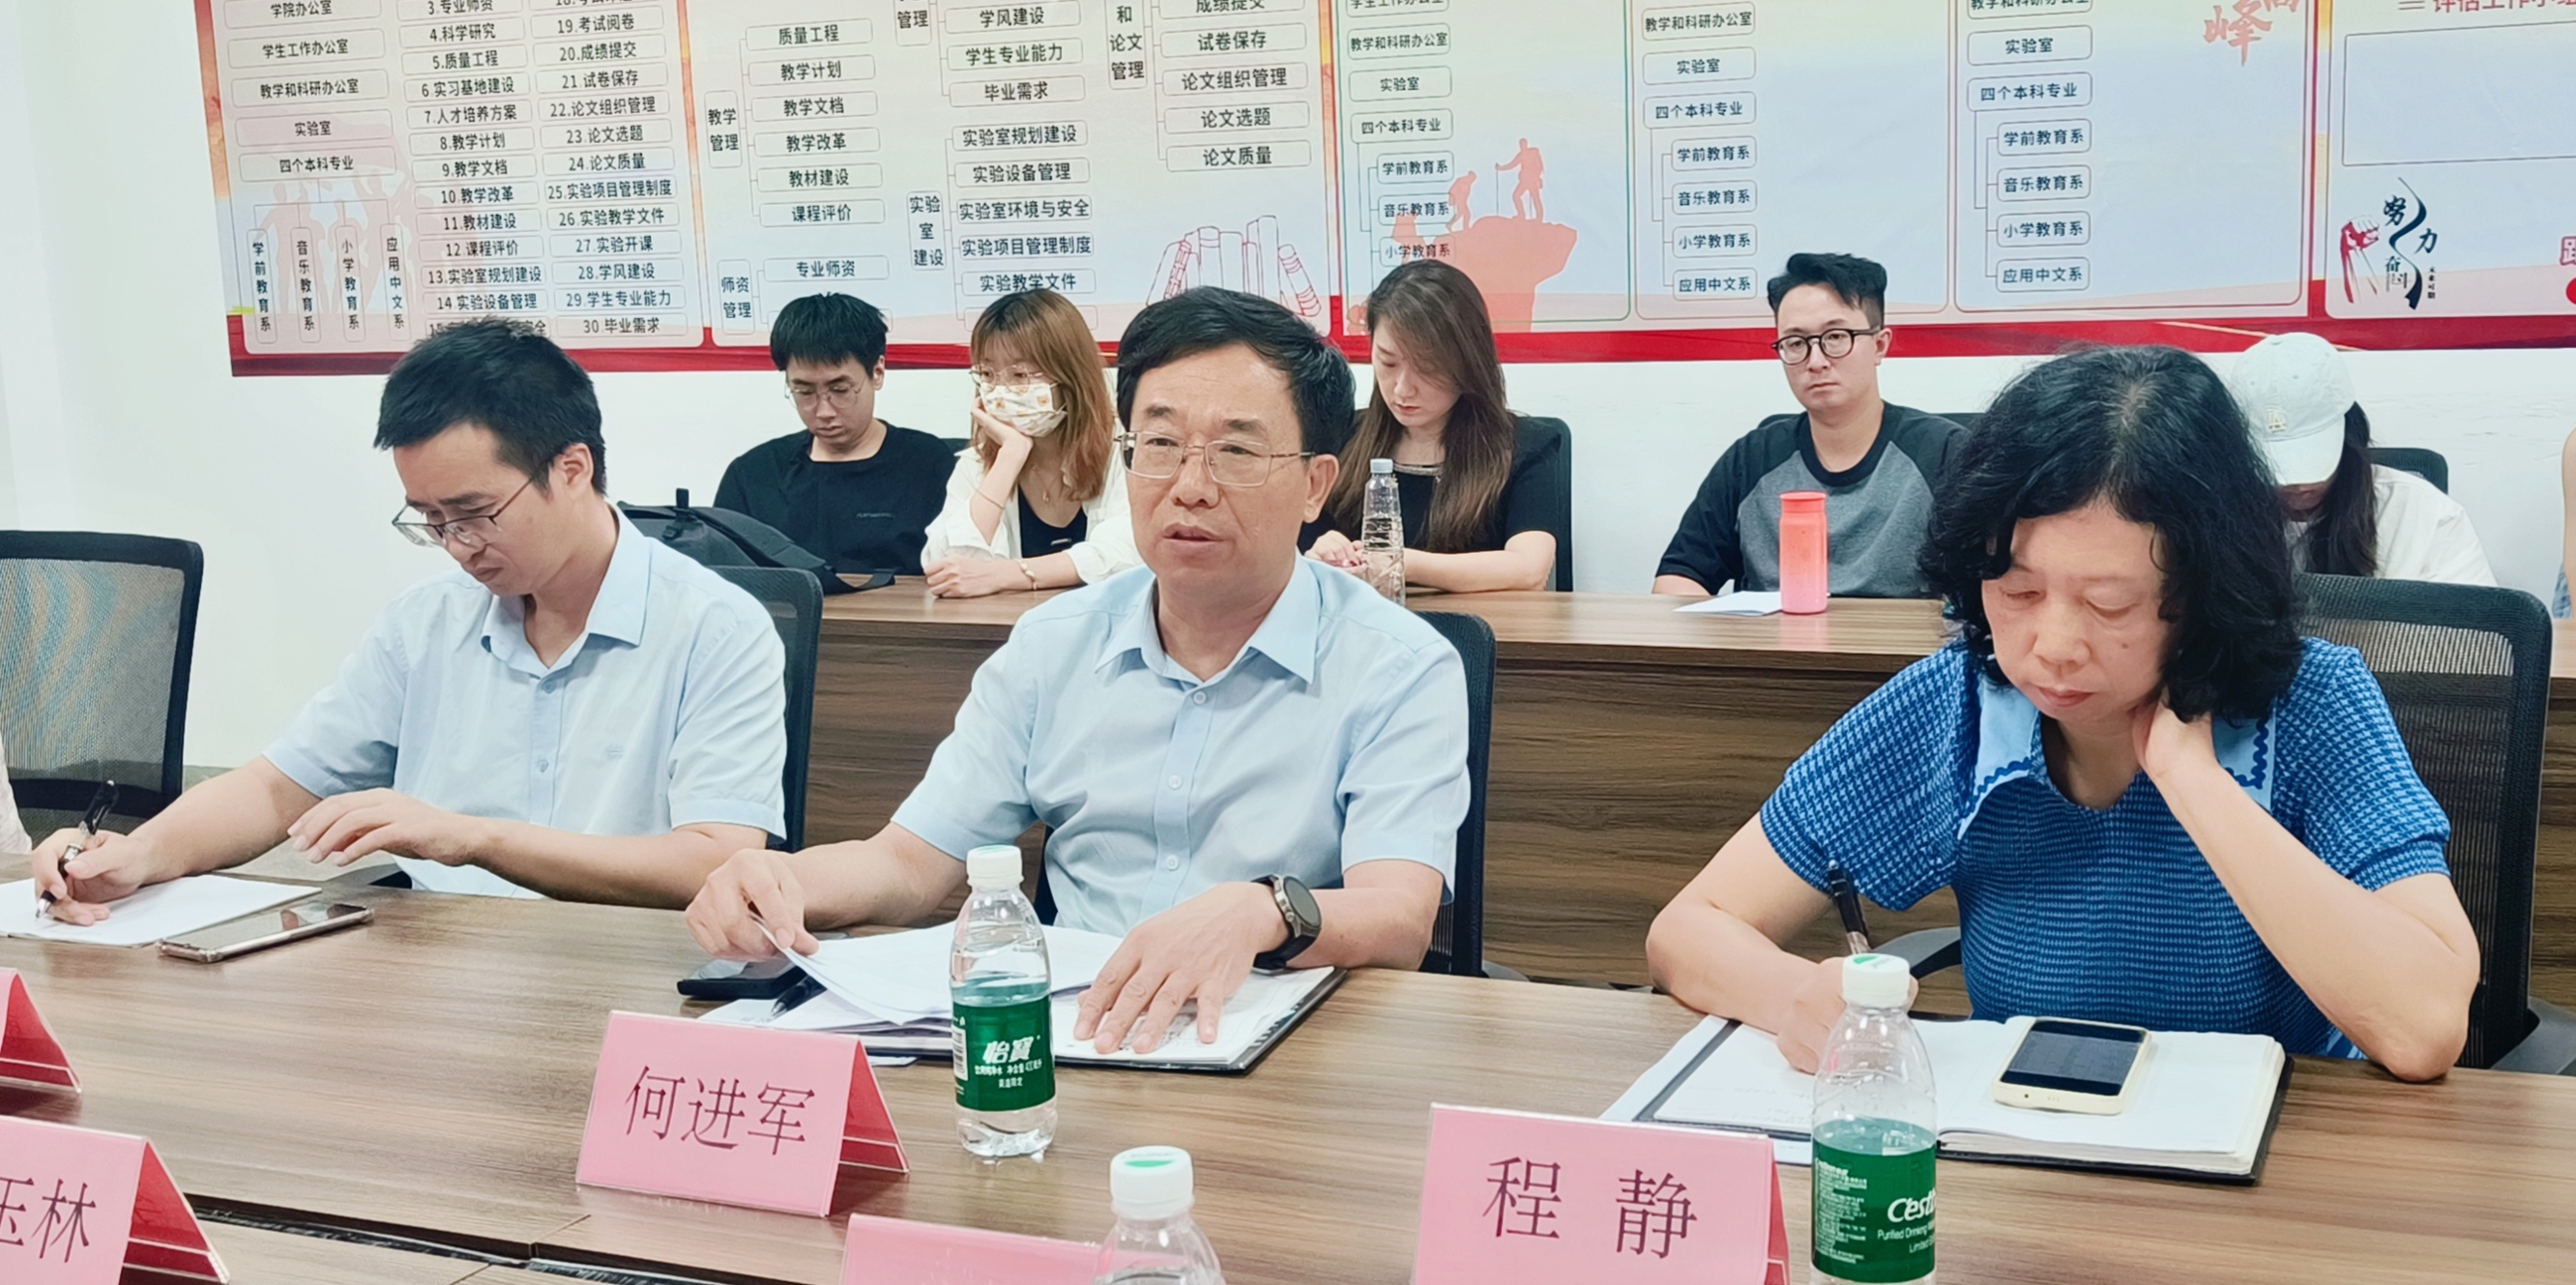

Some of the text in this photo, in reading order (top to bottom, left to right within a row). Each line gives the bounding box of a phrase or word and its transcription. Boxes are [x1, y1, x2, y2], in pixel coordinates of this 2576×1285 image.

[269, 0, 333, 19] 学院办公室
[897, 9, 929, 30] 管理
[979, 6, 1044, 29] 学风建设
[1117, 5, 1132, 24] 和
[558, 13, 635, 35] 19.考试阅卷
[1645, 11, 1753, 33] 教学和科研办公室
[429, 22, 496, 43] 4.科学研究
[779, 24, 840, 46] 质量工程
[1197, 29, 1266, 52] 试卷保存
[1350, 28, 1449, 53] 教学和科研办公室
[262, 38, 349, 59] 学生工作办公室
[559, 41, 637, 62] 20.成绩提交
[1109, 33, 1143, 53] 论文
[2004, 37, 2054, 54] 实验室
[432, 49, 499, 70] 5.质量工程
[965, 43, 1063, 66] 学生专业能力
[780, 59, 842, 82] 教学计划
[1111, 60, 1145, 81] 管理
[1676, 57, 1721, 75] 实验室
[260, 77, 360, 99] 教学和科研办公室
[421, 75, 515, 98] 6.实习基地建设
[562, 68, 639, 89] 21.试卷保存
[1181, 66, 1288, 91] 论文组织管理
[1379, 75, 1420, 92] 实验室
[984, 80, 1048, 102] 毕业需求
[1980, 82, 2079, 102] 四个本科专业
[424, 103, 517, 125] 7.人才培养方案
[550, 95, 656, 118] 22.论文组织管理
[783, 96, 845, 117] 教学文档
[1655, 101, 1743, 120] 四个本科专业
[707, 108, 737, 126] 教学
[1200, 107, 1271, 129] 论文选题
[1361, 117, 1442, 135] 四个本科专业
[294, 120, 332, 137] 实验室
[566, 124, 644, 145] 23.论文选题
[962, 124, 1077, 148] 实验室规划建设
[2003, 128, 2084, 147] 学前教育系
[439, 131, 506, 152] 8.教学计划
[709, 133, 739, 153] 管理
[786, 132, 847, 154] 教学改革
[569, 152, 646, 171] 24.论文质量
[1202, 146, 1272, 166] 论文质量
[1676, 145, 1750, 162] 学前教育系
[278, 155, 354, 173] 四个本科专业
[442, 159, 508, 178] 9.教学文档
[972, 161, 1071, 183] 实验设备管理
[1382, 159, 1449, 176] 学前教育系
[789, 167, 849, 188] 教材建设
[2002, 173, 2084, 194] 音乐教育系
[548, 178, 673, 200] 25.实验项目管理制度
[1677, 188, 1751, 207] 音乐教育系
[791, 203, 852, 223] 课程评价
[909, 195, 941, 214] 实验
[959, 198, 1090, 221] 实验室环境与安全
[1383, 201, 1449, 218] 音乐教育系
[443, 212, 516, 232] 11.教材建设
[559, 207, 665, 227] 26.实验教学文件
[918, 222, 934, 240] 室
[2003, 220, 2084, 239] 小学教育系
[961, 235, 1092, 257] 实验项目管理制度
[1385, 243, 1451, 260] 小学教育系
[1678, 233, 1751, 250] 小学教育系
[912, 248, 944, 267] 建设
[428, 266, 542, 285] 13.实验室规划建设
[578, 262, 655, 281] 28.学风建设
[796, 260, 855, 278] 专业师资
[2002, 266, 2083, 284] 应用中文系
[252, 242, 271, 332] 学前教育系
[296, 240, 315, 332] 音乐教育系
[342, 239, 360, 330] 小学教育系
[385, 236, 404, 330] 应用中文系
[720, 275, 749, 293] 师资
[979, 272, 1076, 292] 实验教学文件
[1678, 275, 1751, 293] 应用中文系
[722, 301, 752, 319] 管理
[624, 1065, 815, 1156] 何进军
